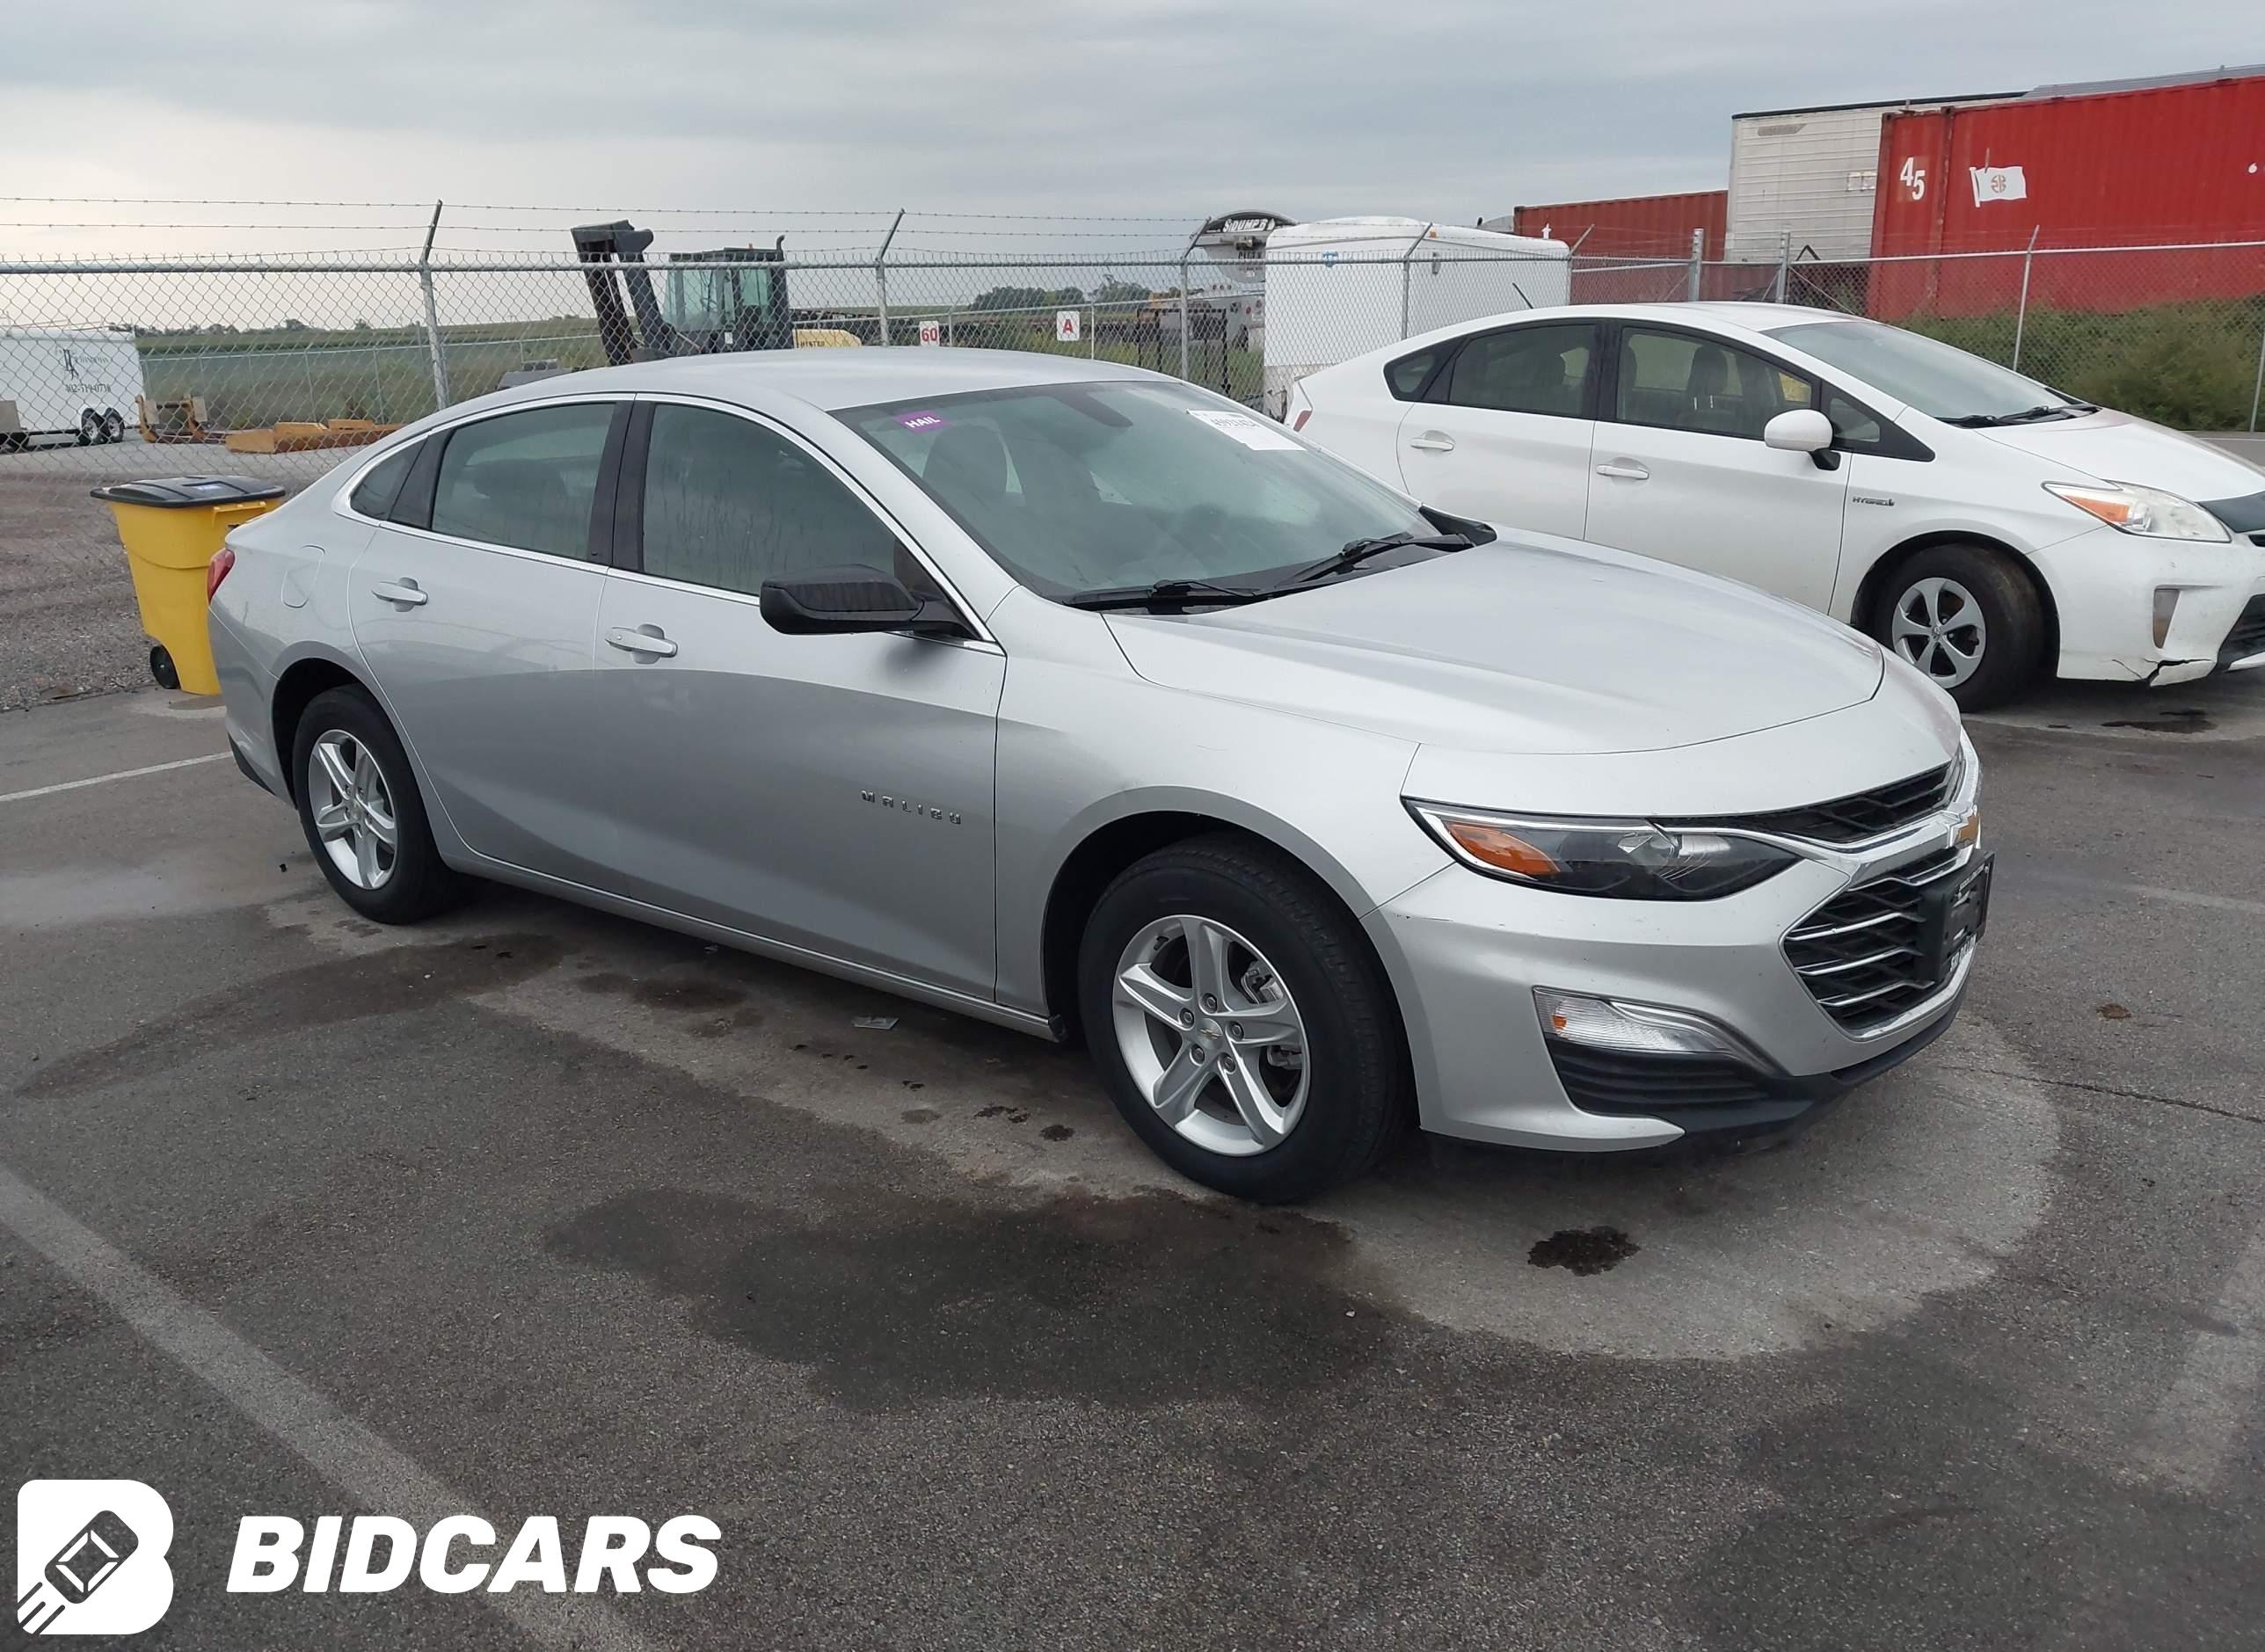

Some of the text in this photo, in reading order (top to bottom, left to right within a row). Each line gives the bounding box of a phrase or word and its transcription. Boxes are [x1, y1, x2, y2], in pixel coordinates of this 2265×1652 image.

[1062, 319, 1074, 333] A
[921, 327, 937, 341] 60
[905, 416, 941, 428] HAIL
[861, 790, 962, 825] MALIBU
